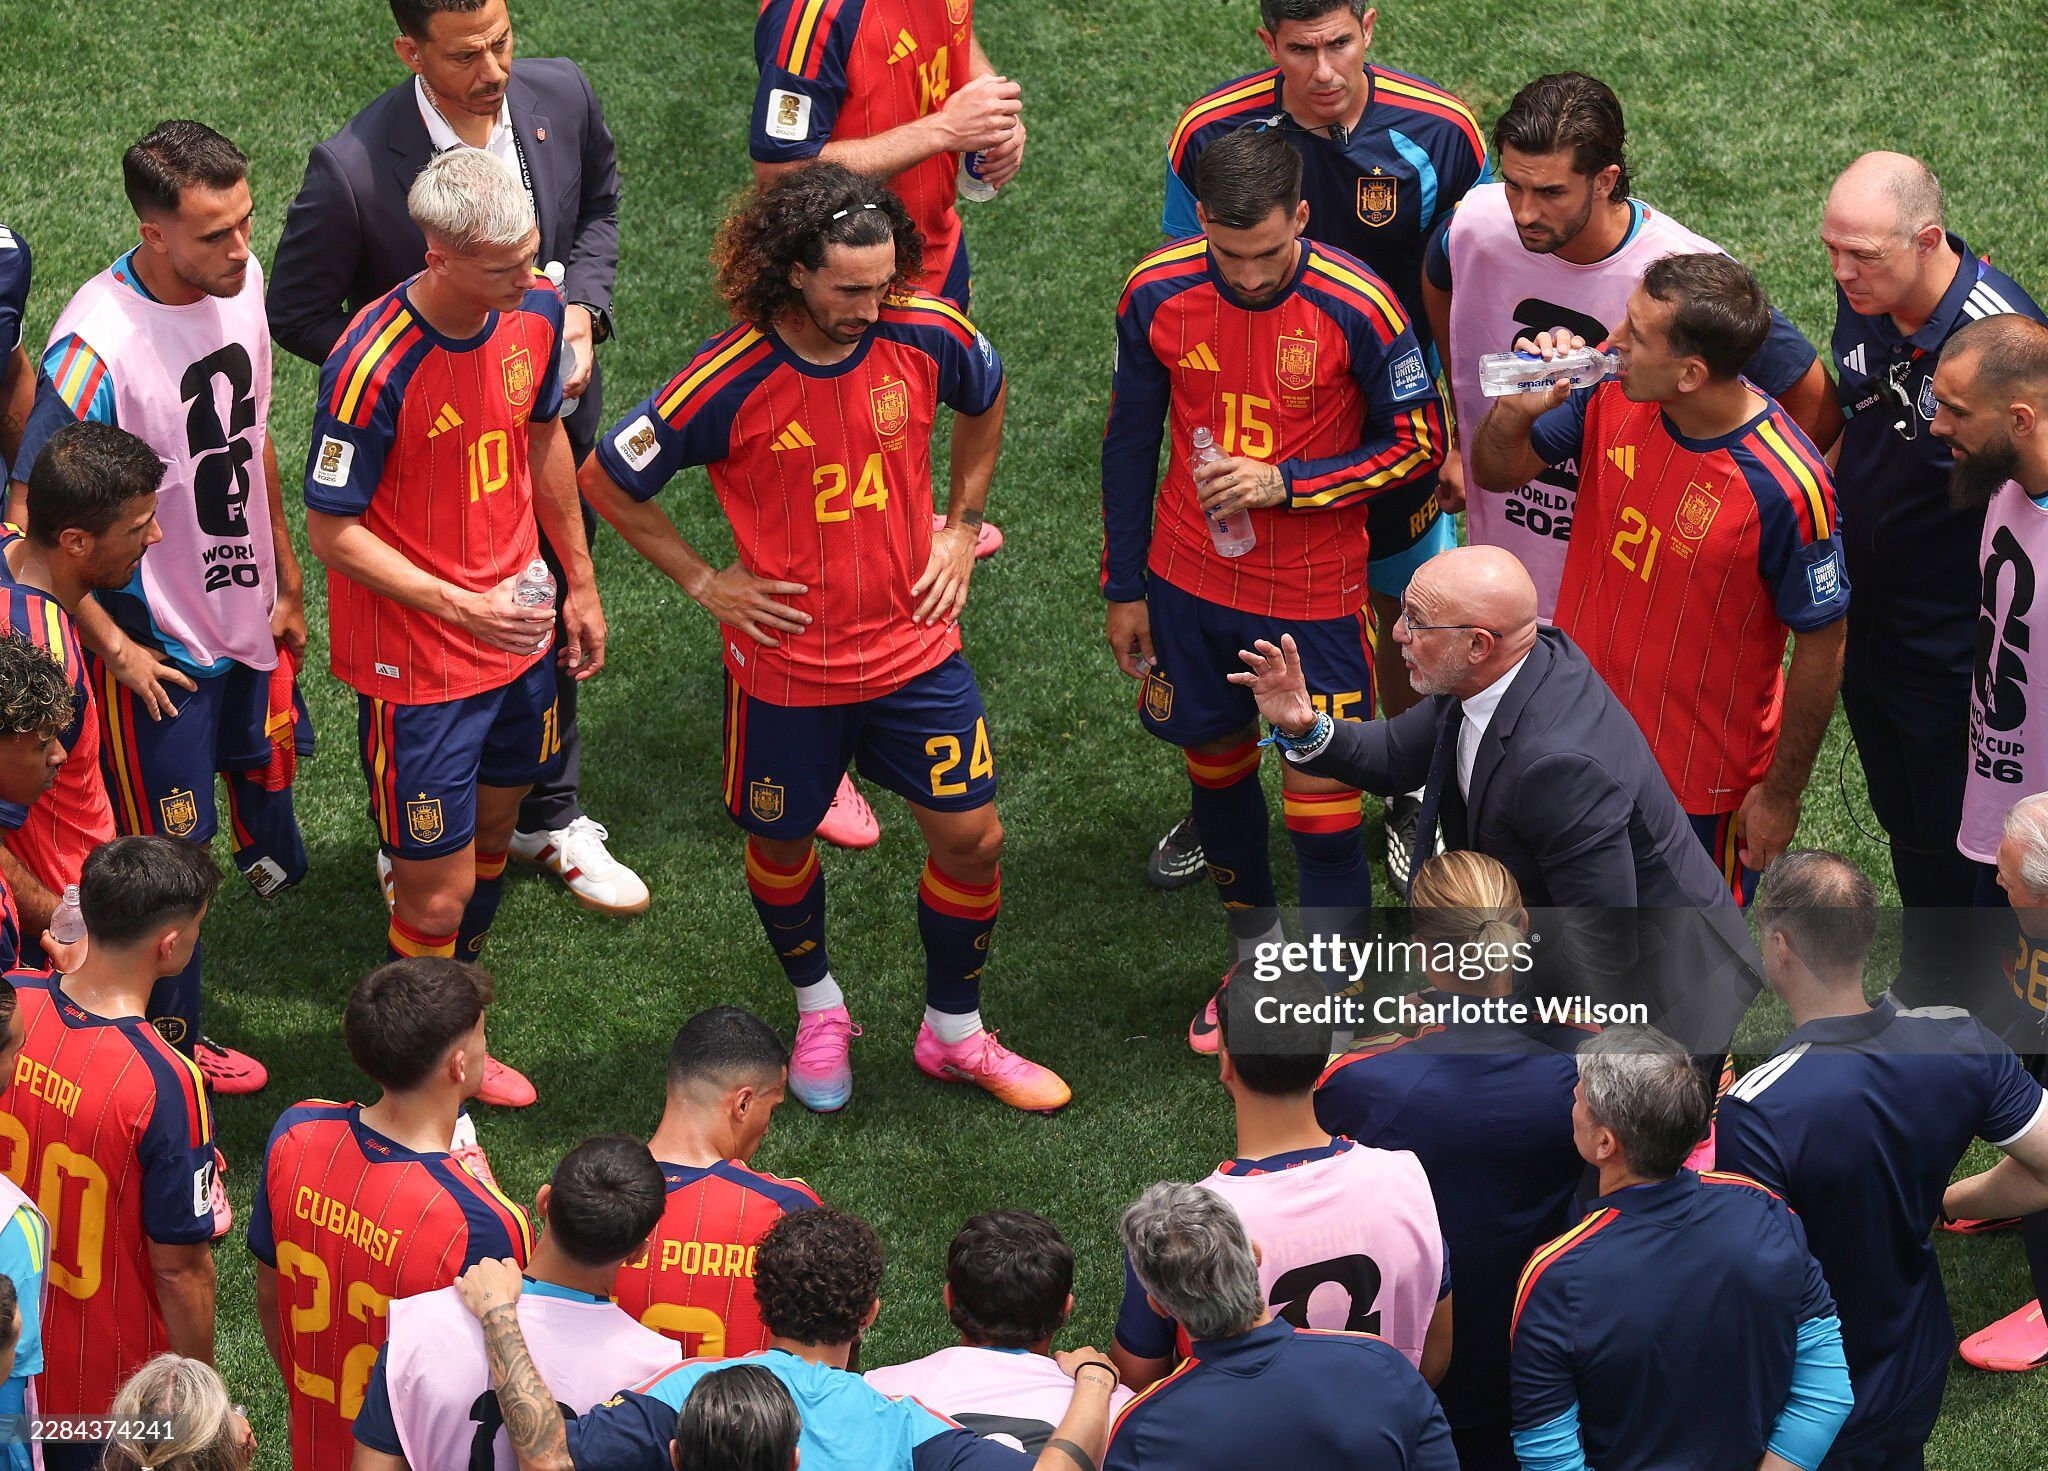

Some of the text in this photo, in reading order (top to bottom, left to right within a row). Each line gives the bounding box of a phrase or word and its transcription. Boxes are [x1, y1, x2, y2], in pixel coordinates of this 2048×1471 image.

[919, 46, 950, 117] 14
[1395, 362, 1421, 379] UNITES
[1517, 376, 1581, 389] smartwer
[1221, 392, 1274, 459] 15
[468, 430, 509, 503] 10
[812, 452, 889, 523] 24
[1504, 498, 1574, 542] 202
[1611, 506, 1662, 583] 21
[203, 543, 255, 566] WORL
[204, 563, 260, 593] 20
[925, 715, 994, 797] 24
[1985, 736, 2025, 757] CUP
[14, 1054, 83, 1118] PEDRI
[295, 1185, 404, 1267] CUBARSÍ
